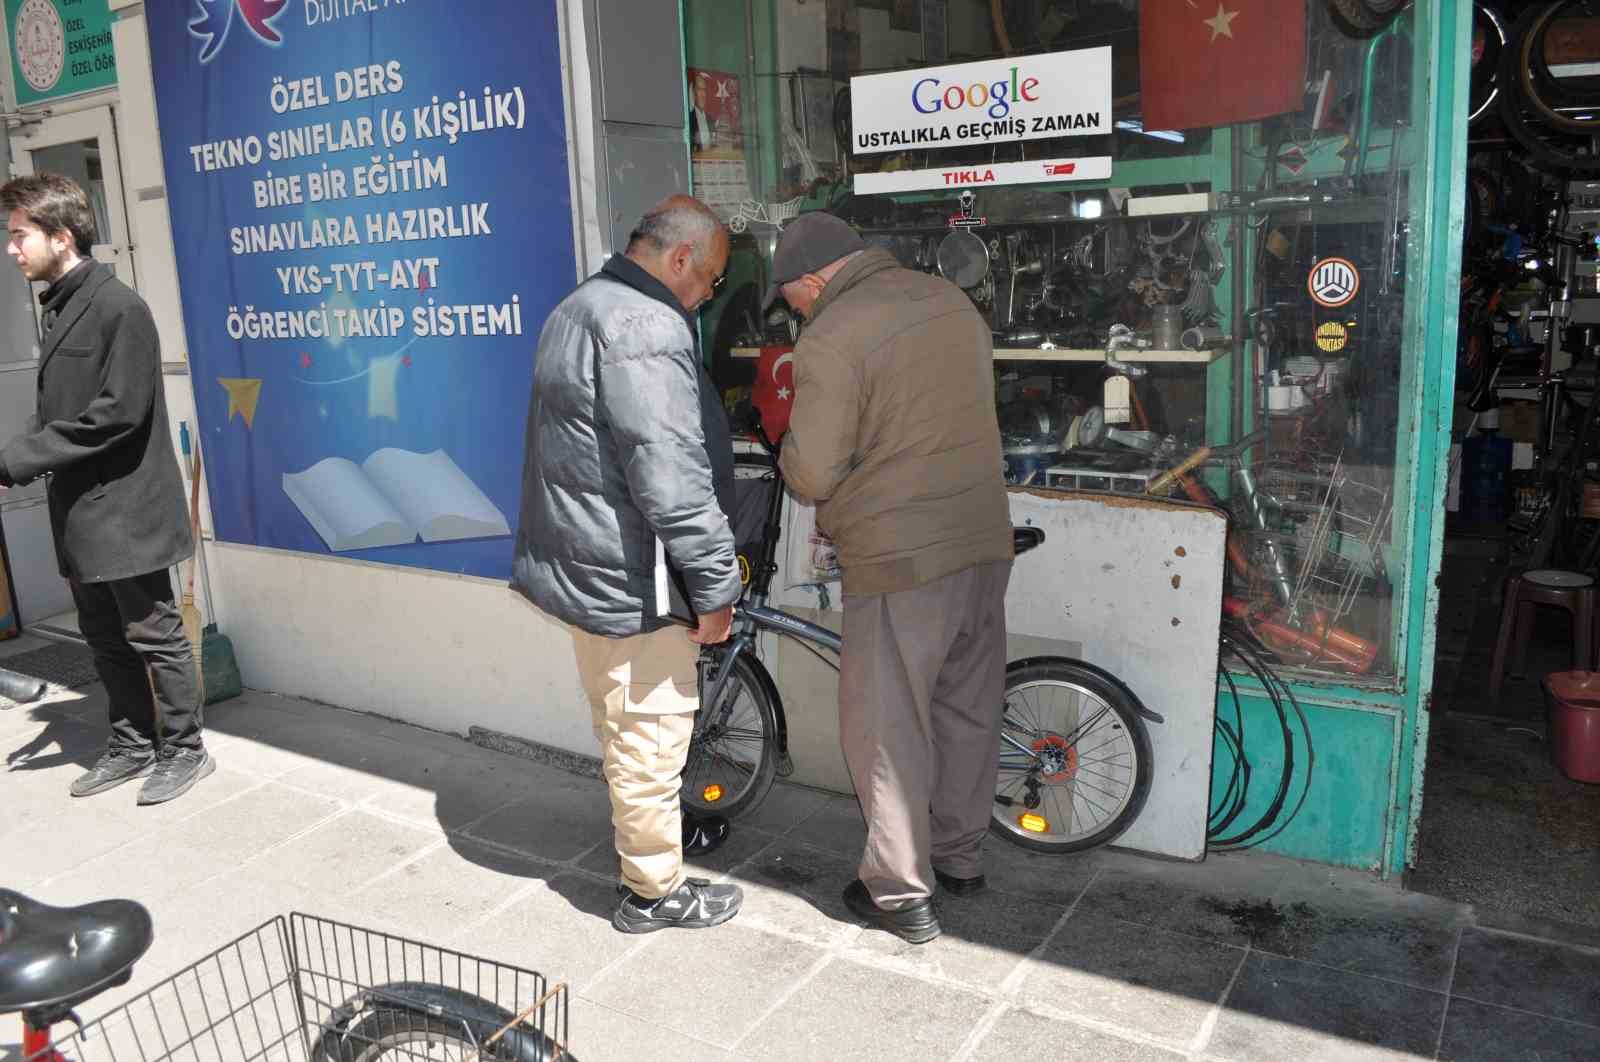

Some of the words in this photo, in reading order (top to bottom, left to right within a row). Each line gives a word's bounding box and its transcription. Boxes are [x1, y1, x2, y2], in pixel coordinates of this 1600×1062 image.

[66, 18, 85, 32] ÖZEL
[71, 60, 93, 77] ÖZEL
[270, 75, 330, 114] ÖZEL
[334, 60, 404, 102] DERS
[911, 66, 1040, 119] Google
[189, 135, 263, 173] TEKNO
[267, 116, 375, 161] SINIFLAR
[381, 108, 407, 148] (6
[413, 86, 526, 145] KİŞİLİK)
[858, 128, 951, 148] USTALIKLA
[956, 116, 1026, 141] GEÇMİŞ
[1032, 112, 1101, 133] ZAMAN
[253, 170, 304, 208] BİRE
[308, 162, 348, 202] BİR
[352, 149, 448, 197] EĞİTİM
[942, 169, 996, 185] TIKLA
[230, 215, 361, 255] SINAVLARA
[365, 202, 492, 245] HAZIRLIK
[276, 257, 440, 295] YKS-TYT-AYT
[226, 302, 331, 340] ÖĞRENCİ
[334, 299, 405, 338] TAKİP
[412, 294, 523, 338] SİSTEMİ
